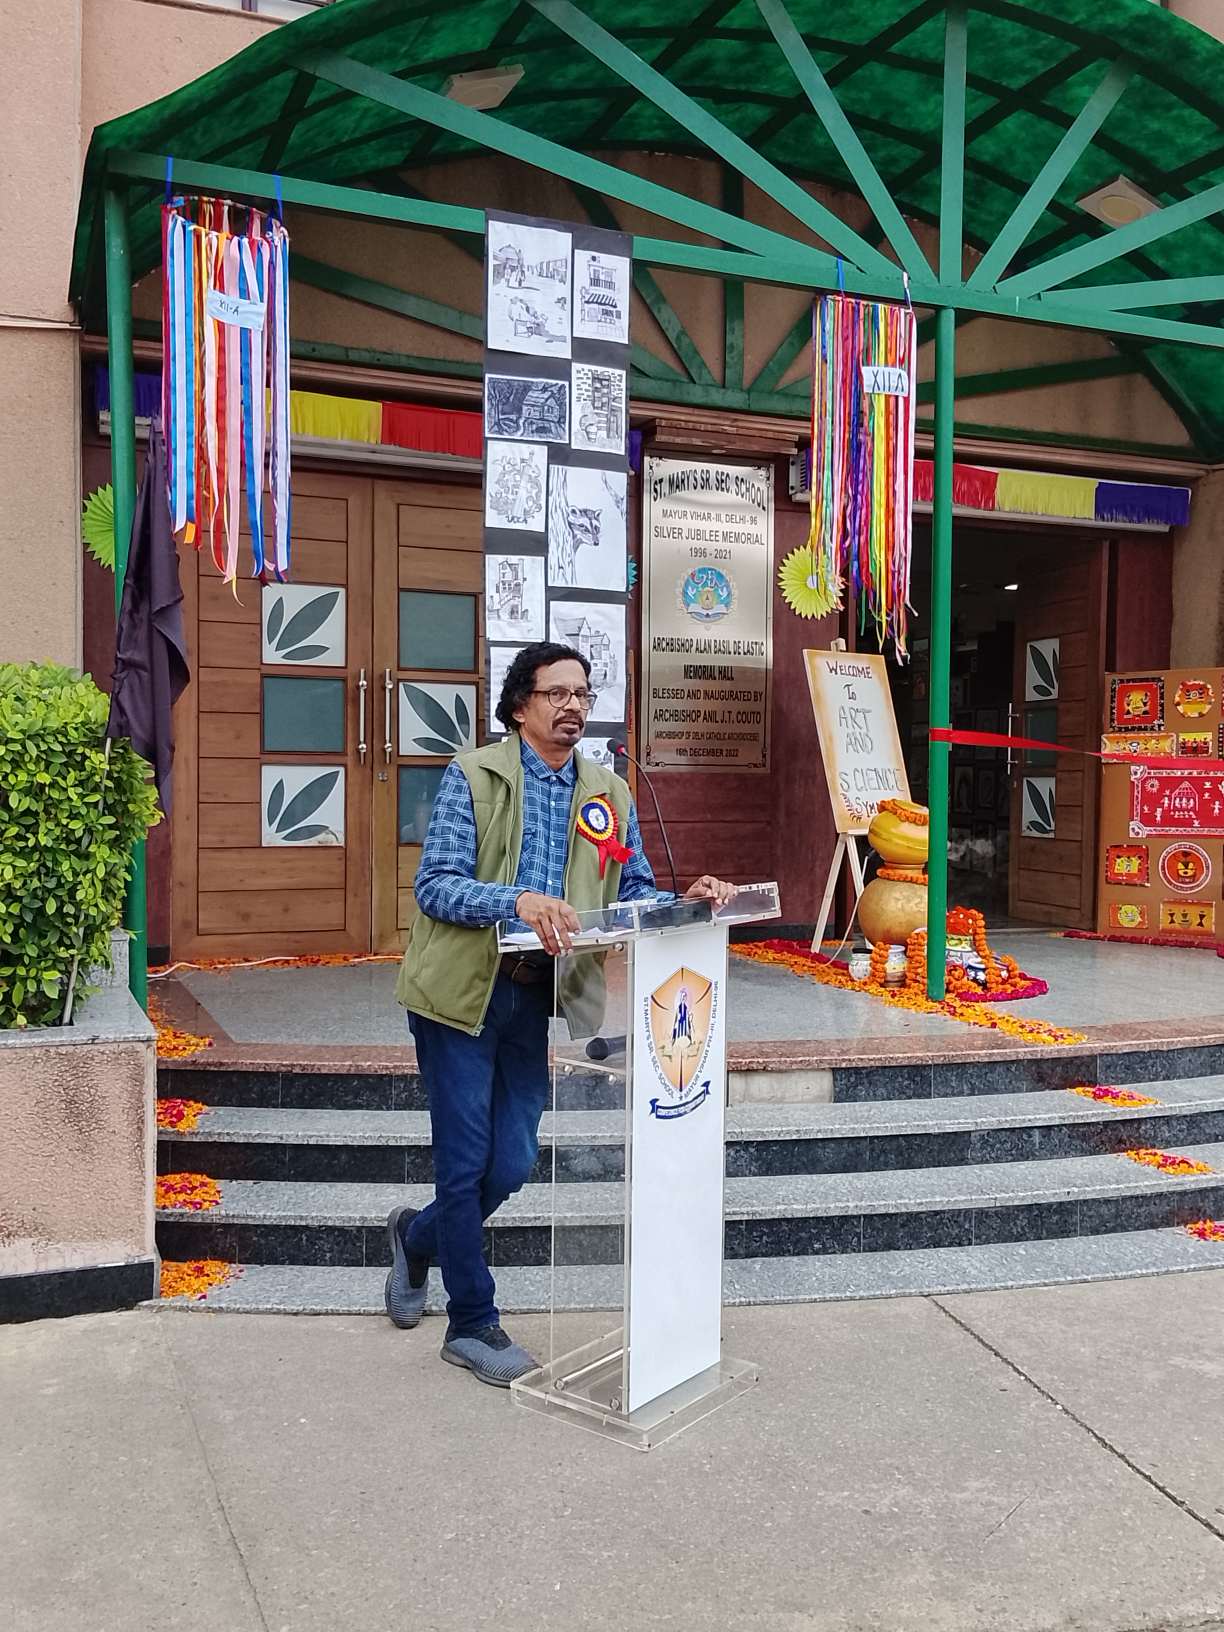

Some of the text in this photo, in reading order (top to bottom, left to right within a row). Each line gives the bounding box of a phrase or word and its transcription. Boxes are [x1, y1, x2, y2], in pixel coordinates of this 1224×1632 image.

[653, 469, 766, 512] ST. MARY'S SR. SEC. SCHOOL
[662, 509, 688, 520] MAYUR
[654, 526, 765, 545] SILVER JUBILEE MEMORIAL
[689, 547, 707, 559] 1996
[714, 548, 732, 560] 2021
[652, 637, 765, 657] ARCHBISHOP ALAN BASIL DE LASTIC
[683, 664, 735, 681] MEMORIAL HALL
[652, 687, 763, 702] BLESSED AND INAUGURATED BY
[653, 709, 701, 723] ARCHBISHOP
[702, 710, 719, 724] ANIL
[736, 711, 762, 725] COUTO
[839, 705, 872, 732] ART
[845, 731, 874, 754] AND
[689, 748, 724, 757] DECEMBER
